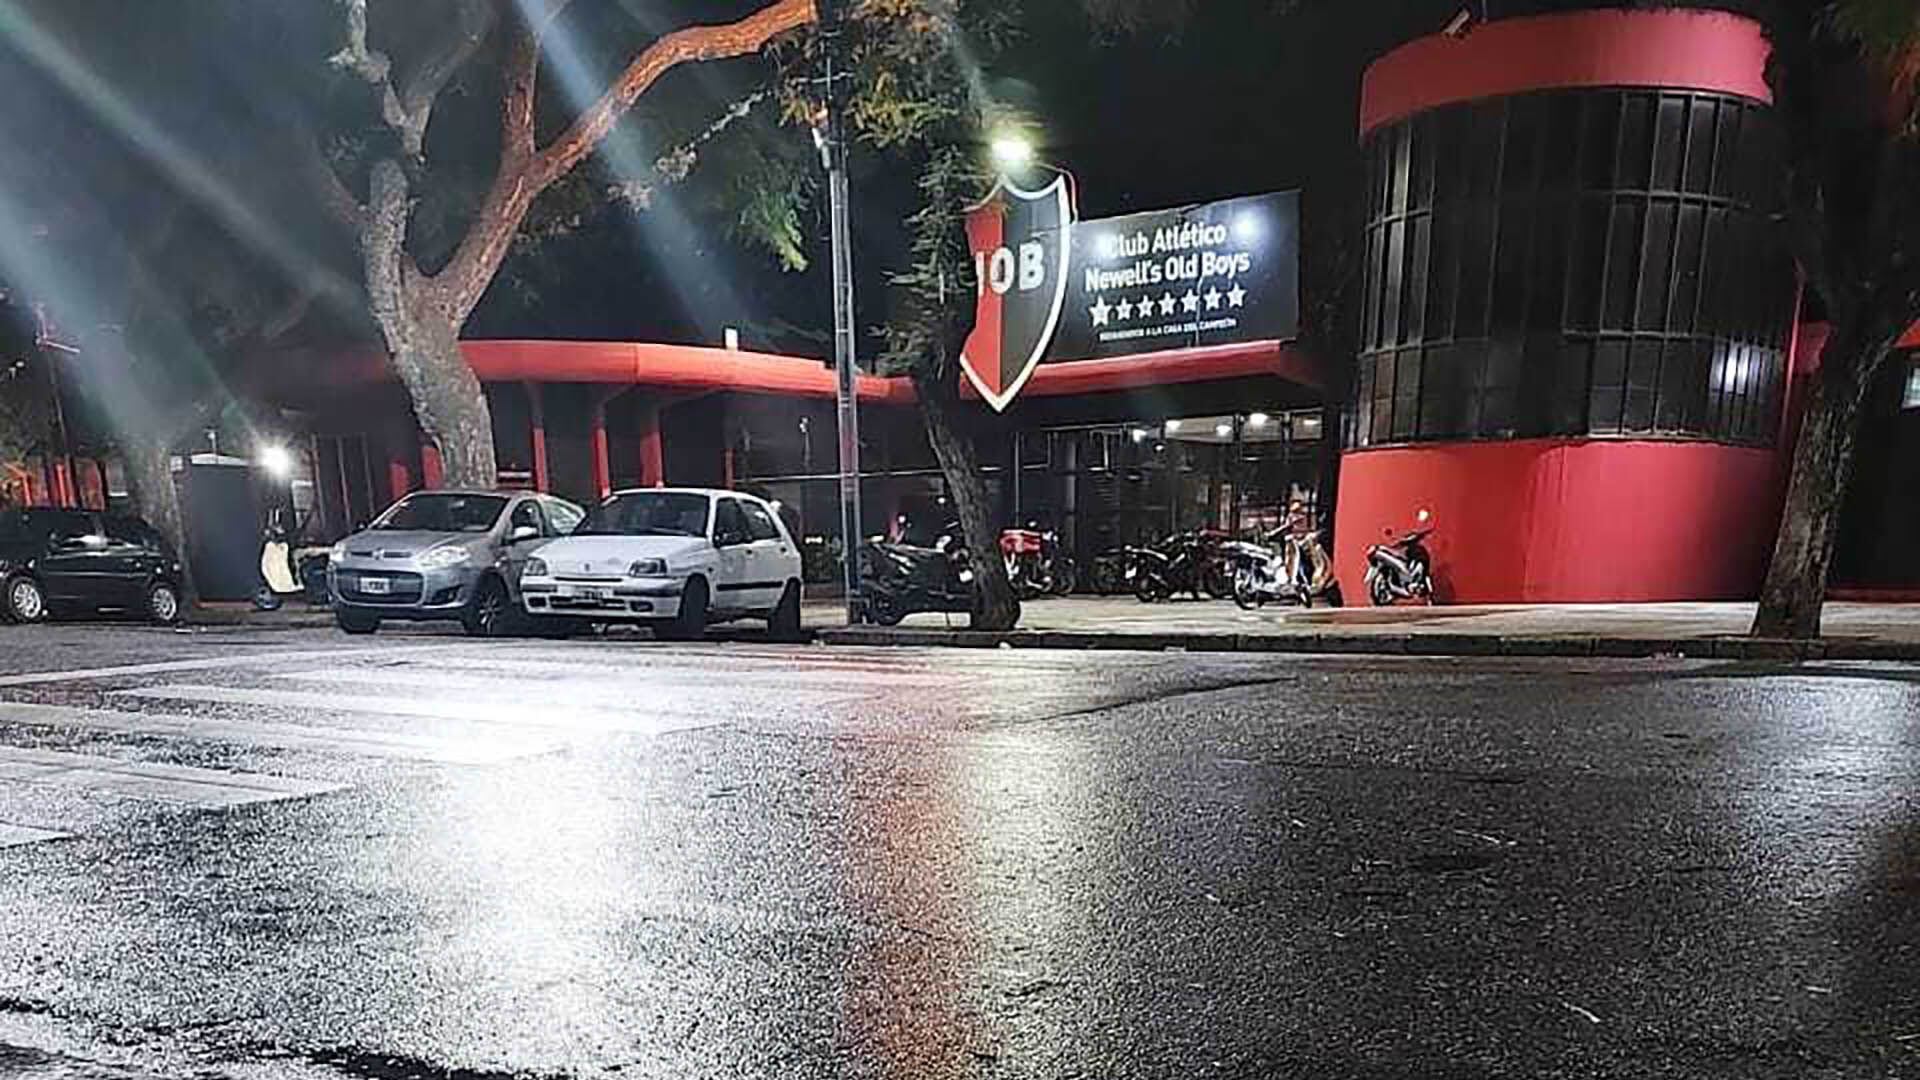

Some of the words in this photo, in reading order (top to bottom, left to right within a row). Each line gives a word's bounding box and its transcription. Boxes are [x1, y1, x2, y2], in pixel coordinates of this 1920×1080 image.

[1102, 229, 1149, 258] Club
[1152, 221, 1227, 252] Atlético
[1085, 259, 1162, 292] Newell's
[1165, 250, 1199, 281] Old
[1202, 250, 1250, 280] Boys
